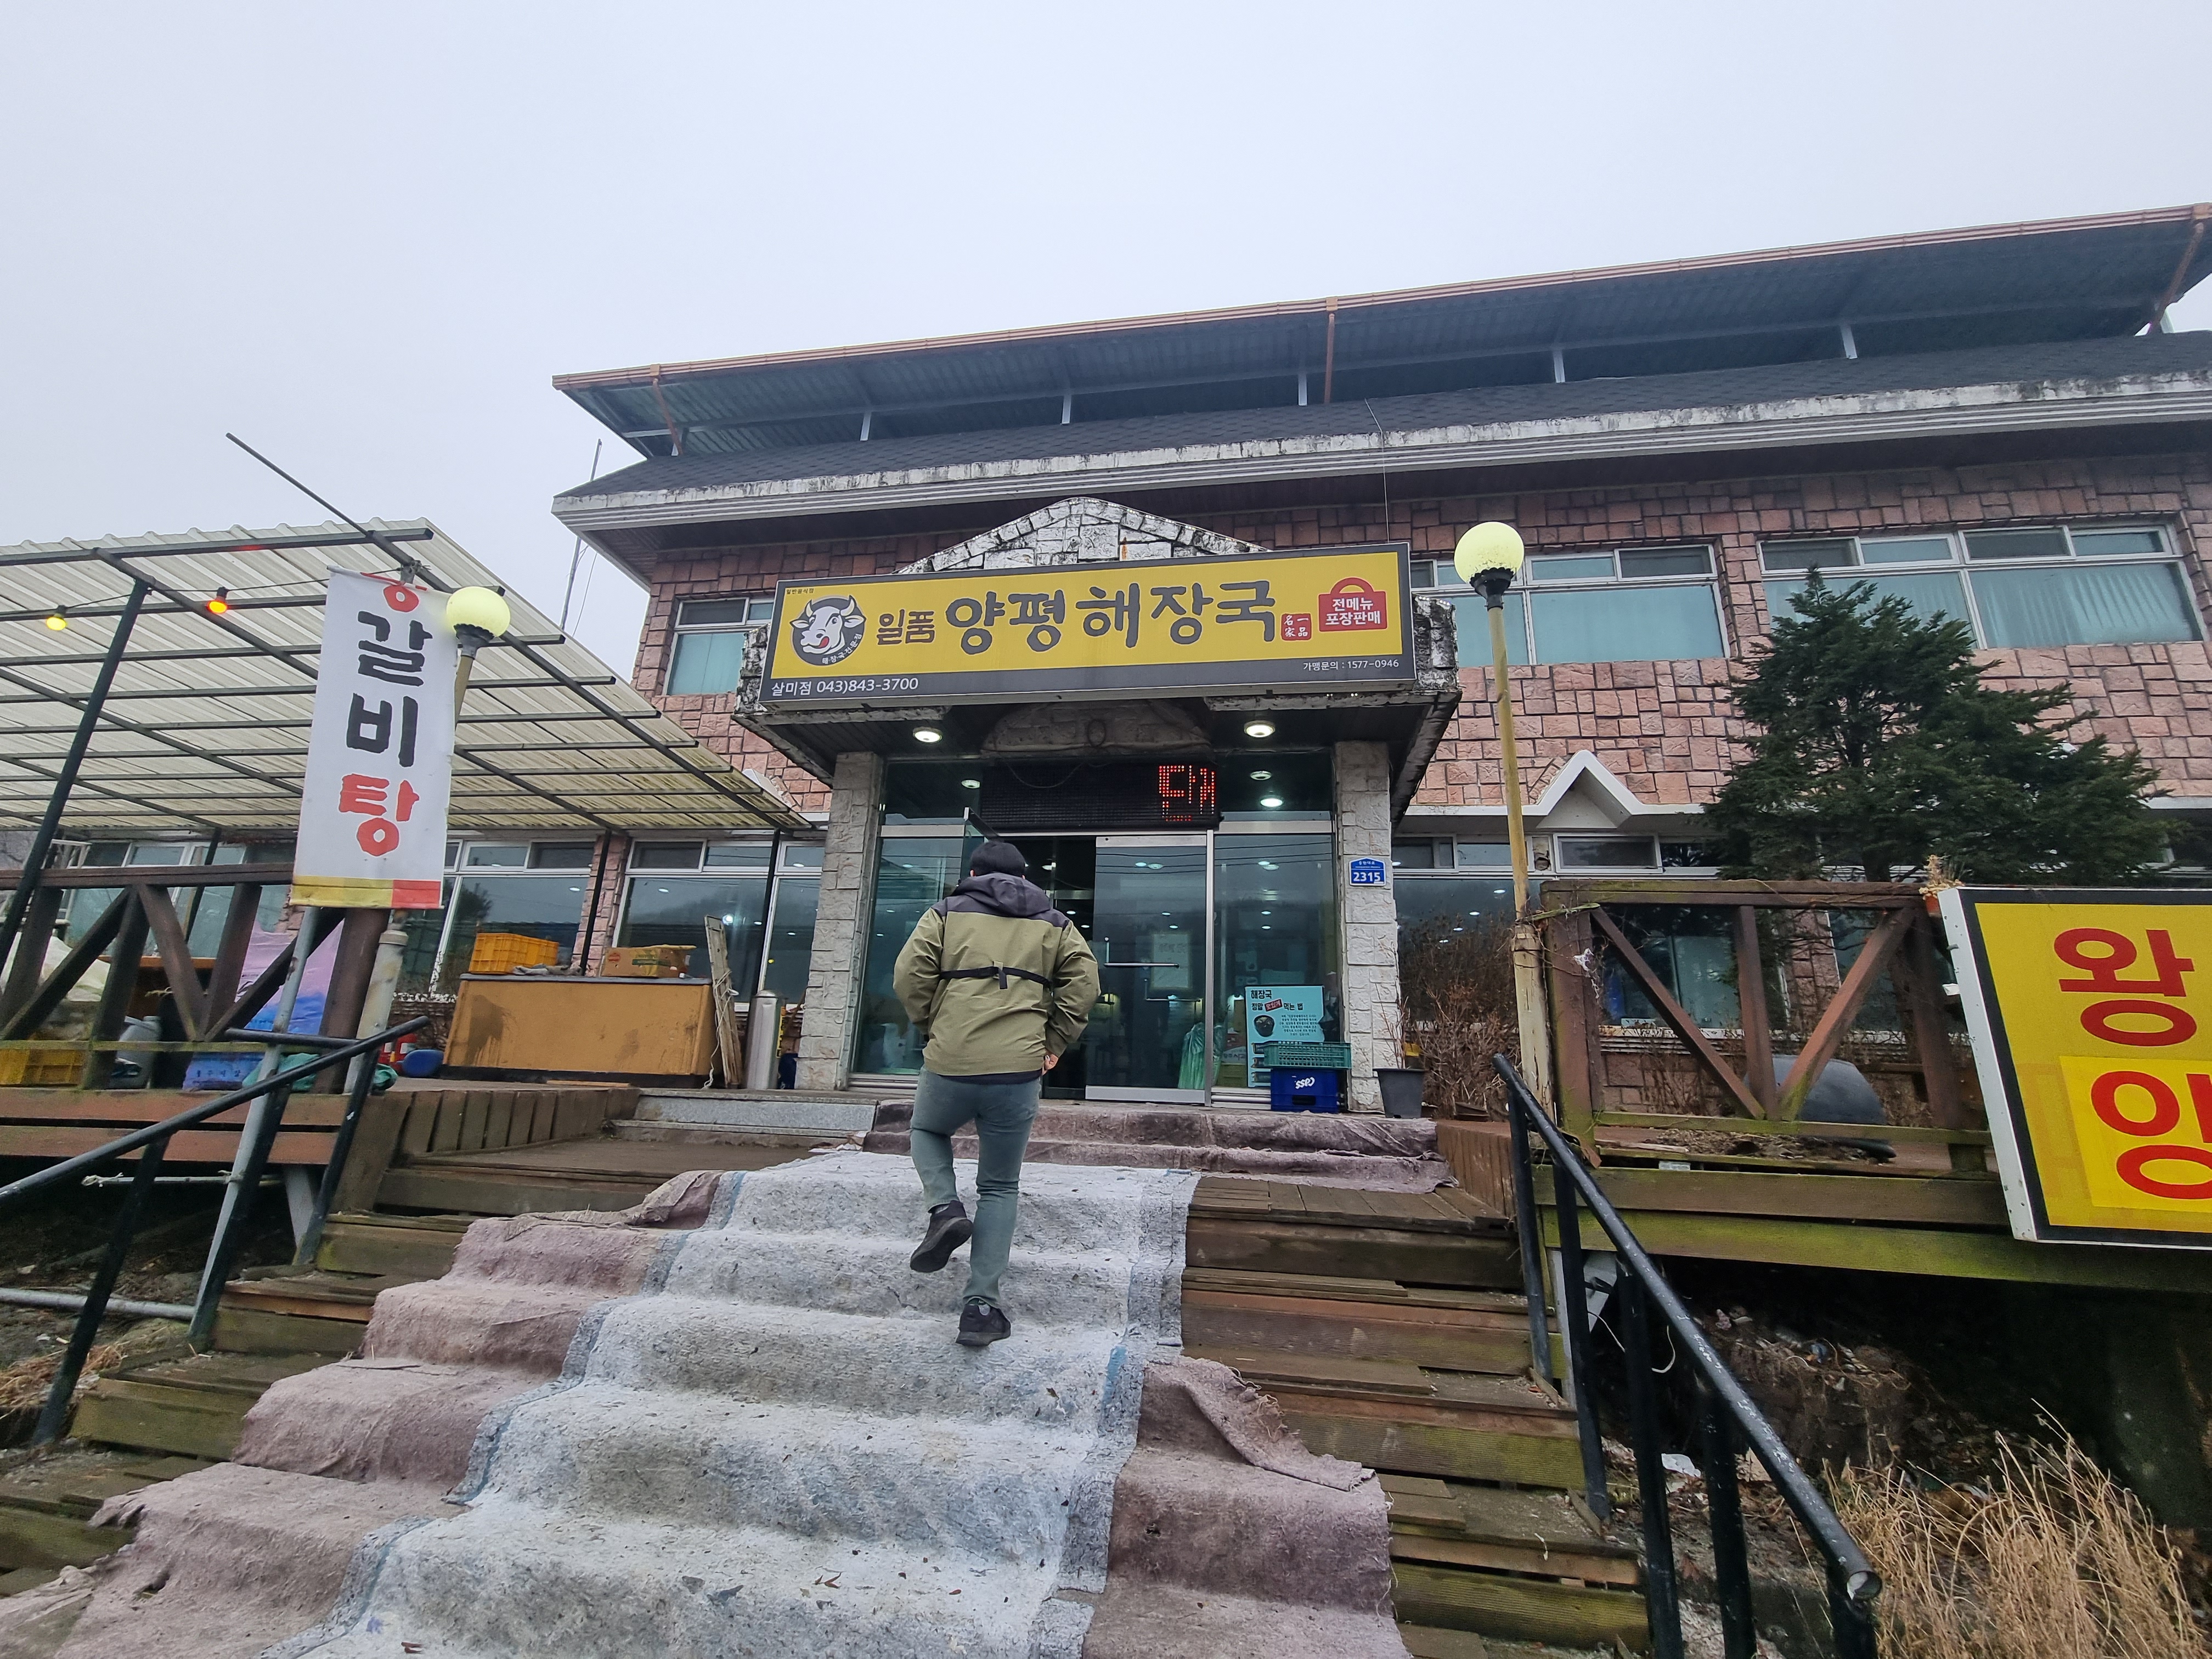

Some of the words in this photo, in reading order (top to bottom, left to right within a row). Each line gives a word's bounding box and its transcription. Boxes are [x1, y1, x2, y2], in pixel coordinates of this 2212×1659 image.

[1332, 597, 1374, 612] 전메뉴
[877, 608, 935, 646] 일품
[945, 580, 1276, 655] 양평해장국
[1325, 611, 1381, 627] 포장판매
[1303, 661, 1339, 672] 가맹문의
[1347, 659, 1400, 669] 1577-0946
[771, 679, 811, 697] 살미점
[816, 677, 919, 693] 043)843-3700
[1353, 872, 1381, 882] 2315
[1251, 989, 1272, 999] 해장국
[2053, 928, 2197, 1047] 왕
[1251, 1002, 1263, 1011] 정말
[1283, 1002, 1295, 1011] 먹는
[1297, 1002, 1304, 1011] 법
